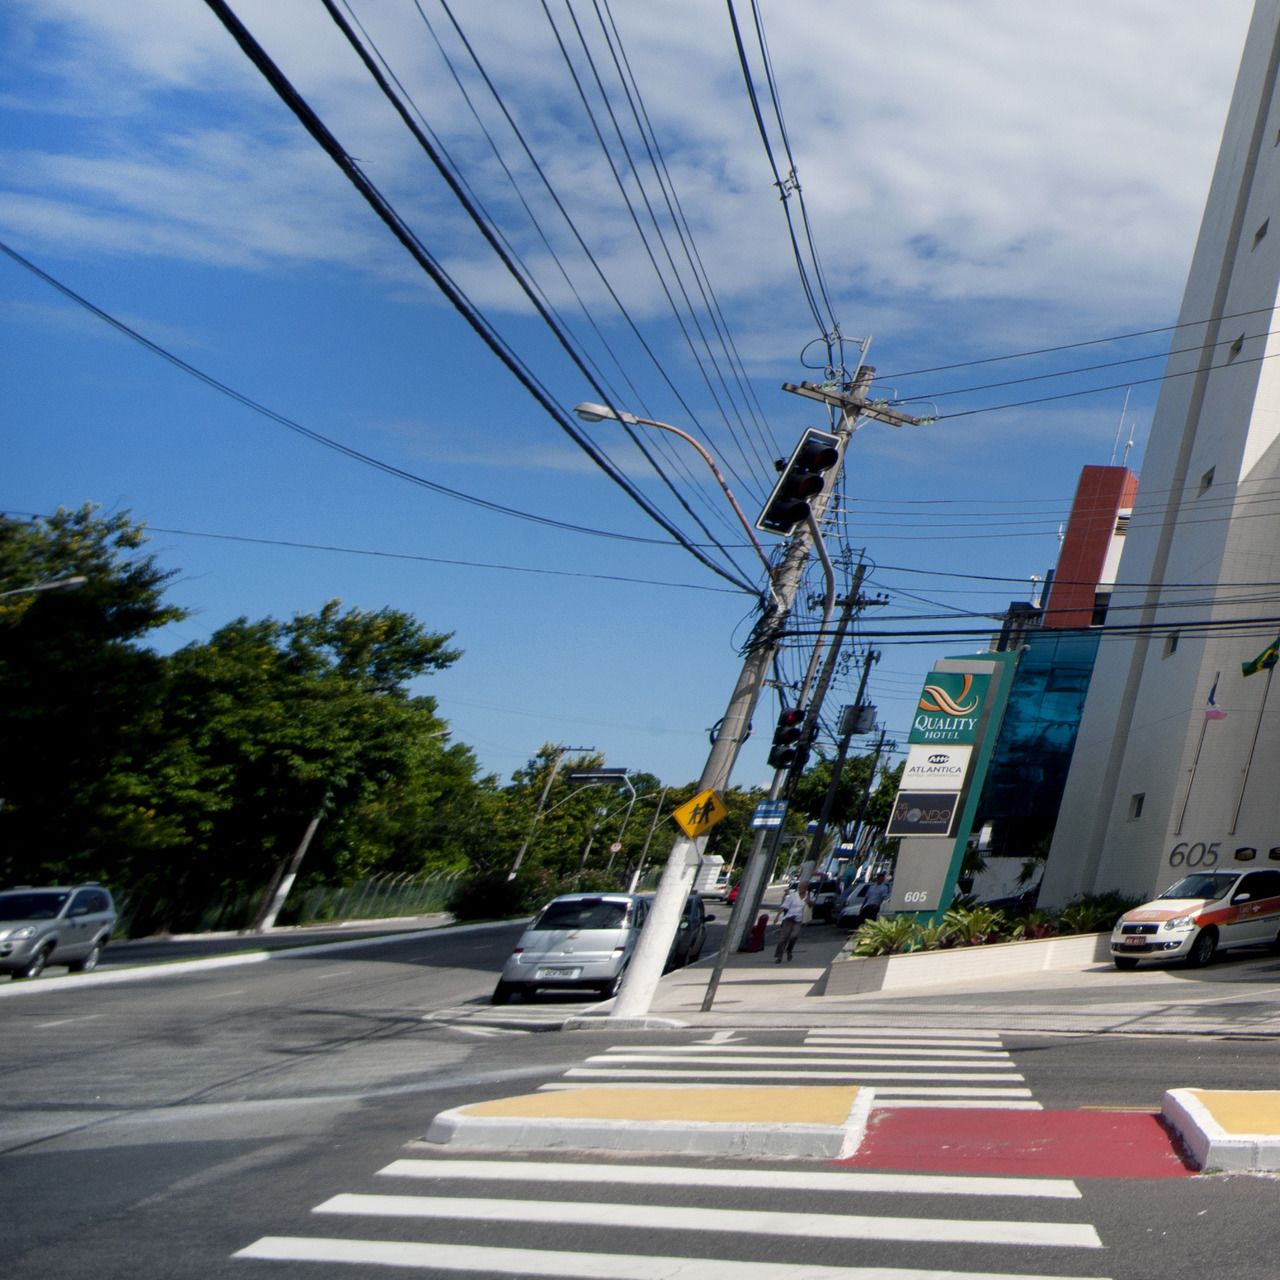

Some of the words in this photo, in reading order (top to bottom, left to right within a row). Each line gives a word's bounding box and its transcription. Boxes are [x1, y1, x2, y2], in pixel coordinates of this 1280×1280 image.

[914, 714, 978, 731] QUALITY
[924, 731, 960, 740] HOTEL
[908, 766, 962, 774] ATLANTICA
[1169, 842, 1222, 867] 605
[904, 891, 928, 903] 605
